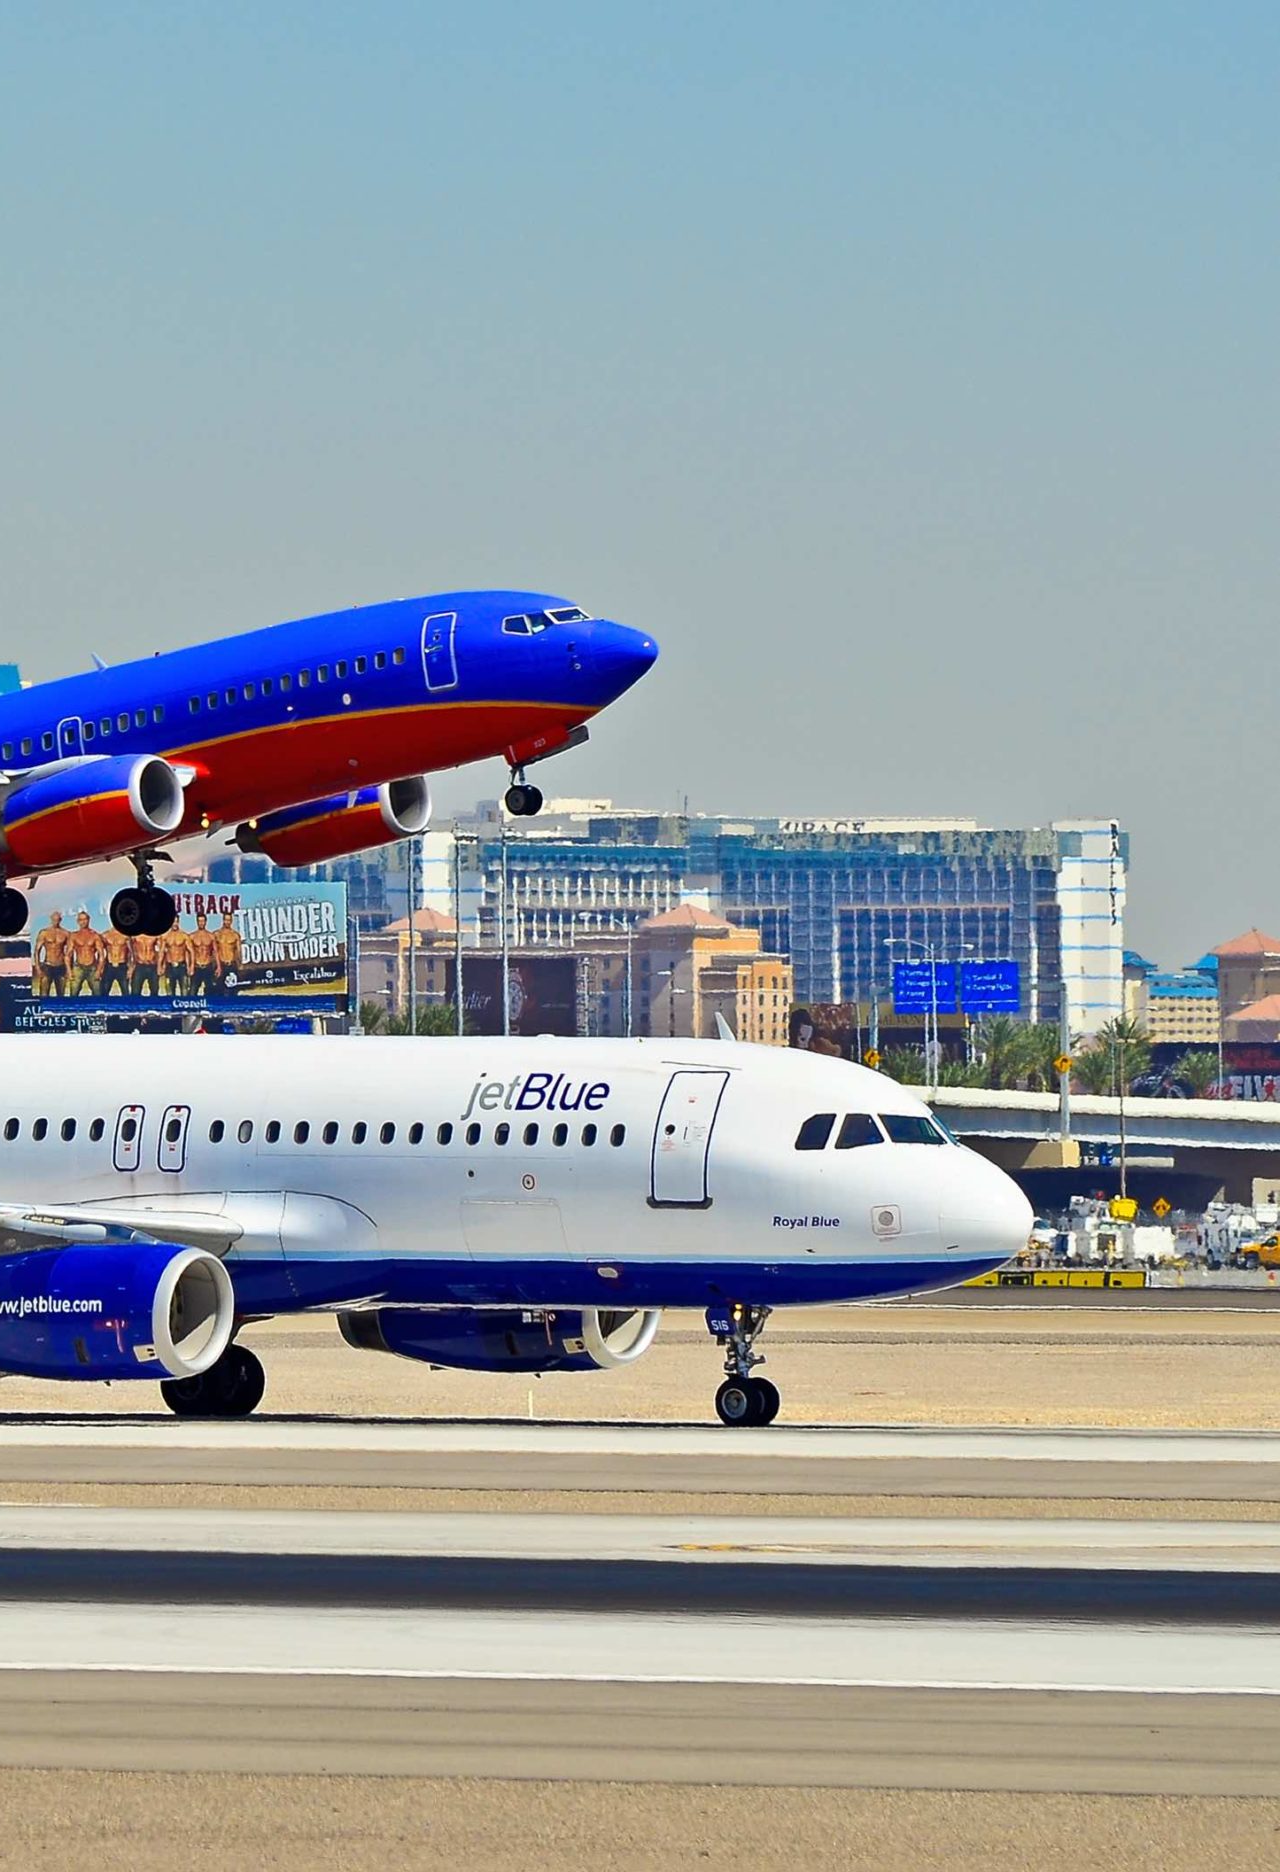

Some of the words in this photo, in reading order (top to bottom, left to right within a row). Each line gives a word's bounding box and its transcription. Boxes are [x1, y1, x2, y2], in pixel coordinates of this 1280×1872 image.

[172, 893, 241, 914] UTBACK
[235, 901, 337, 941] THUNDER
[241, 940, 286, 965] DOWN
[288, 935, 340, 961] UNDER
[293, 966, 338, 984] Excalibur
[460, 1073, 610, 1121] jetBlue
[773, 1216, 808, 1229] Royal
[811, 1216, 840, 1227] Blue
[711, 1319, 729, 1331] 516
